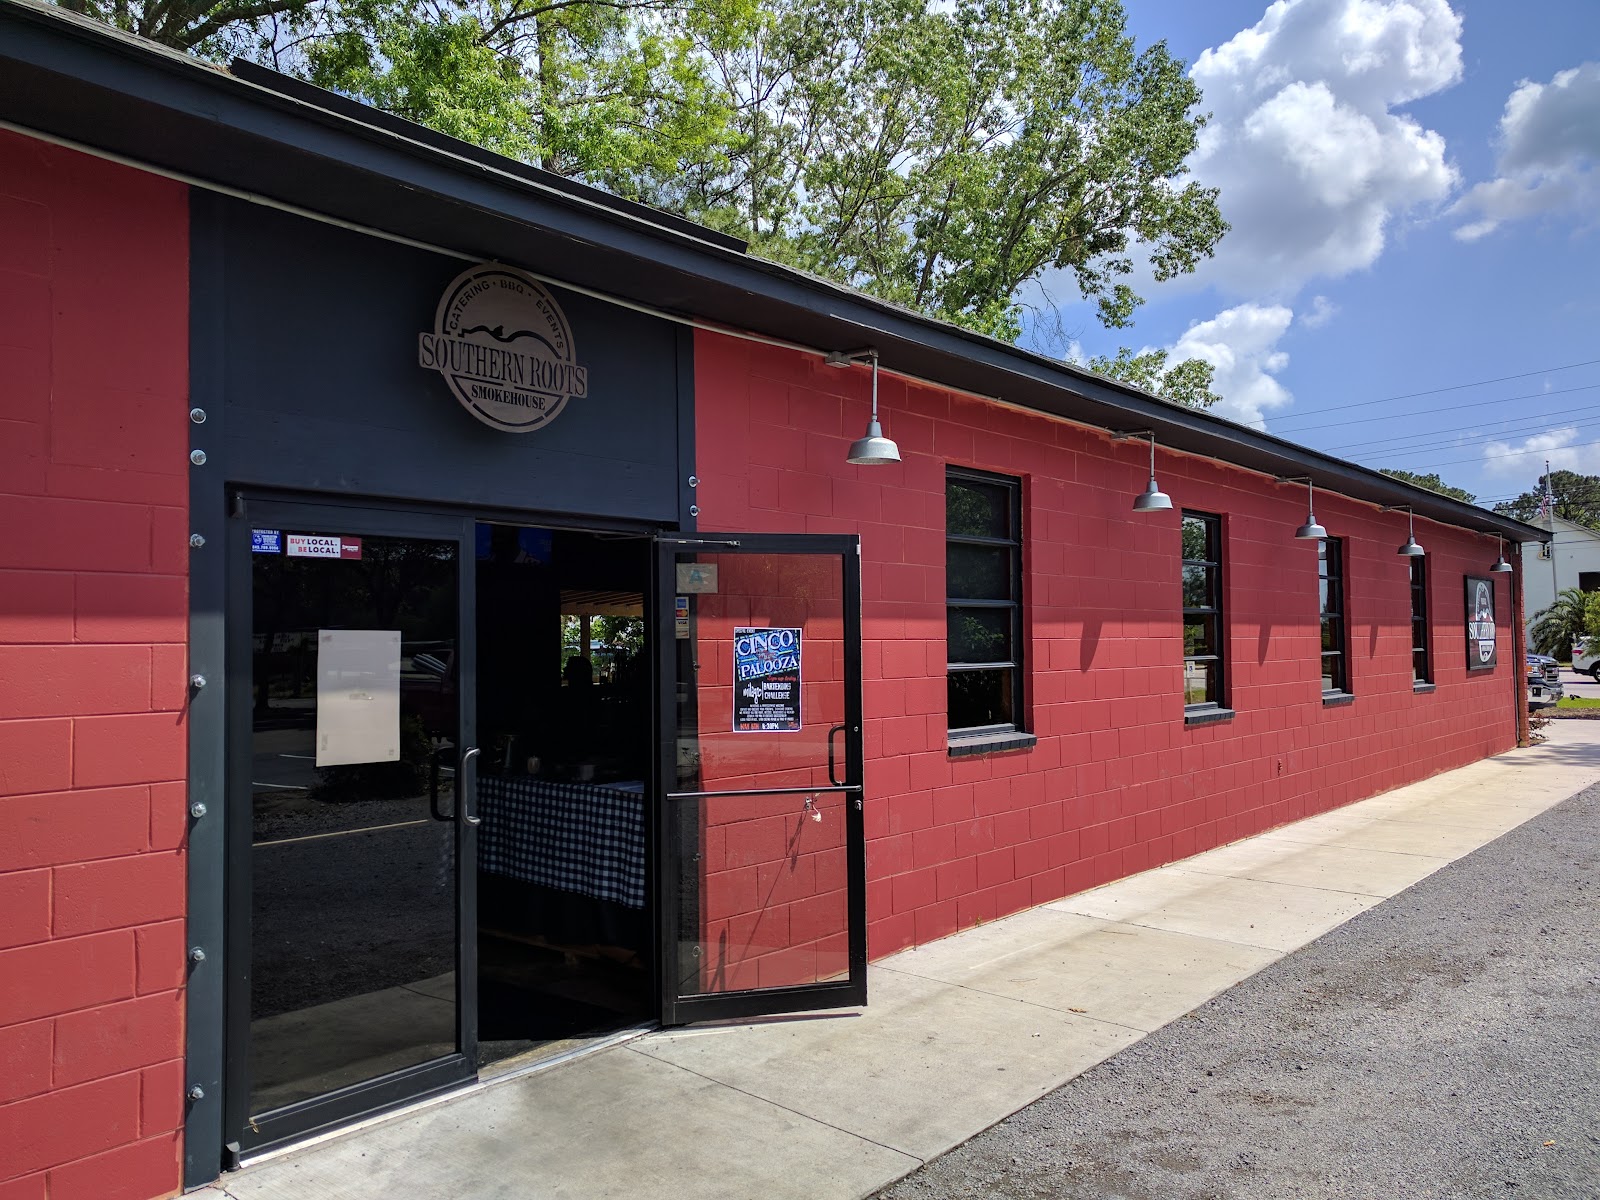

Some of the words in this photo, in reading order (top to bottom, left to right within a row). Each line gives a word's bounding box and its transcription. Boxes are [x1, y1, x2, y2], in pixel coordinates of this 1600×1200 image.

[500, 279, 524, 294] BBQ
[449, 280, 490, 330] CATERING
[535, 300, 564, 349] EVENTS
[421, 334, 525, 385] SOUTHERN
[529, 356, 586, 396] ROOTS
[471, 384, 546, 411] SMOKEHOUSE
[307, 538, 338, 546] LOCAL.
[308, 546, 339, 554] LOCAL.
[737, 630, 794, 656] CINCO
[741, 655, 798, 677] PALOOZA
